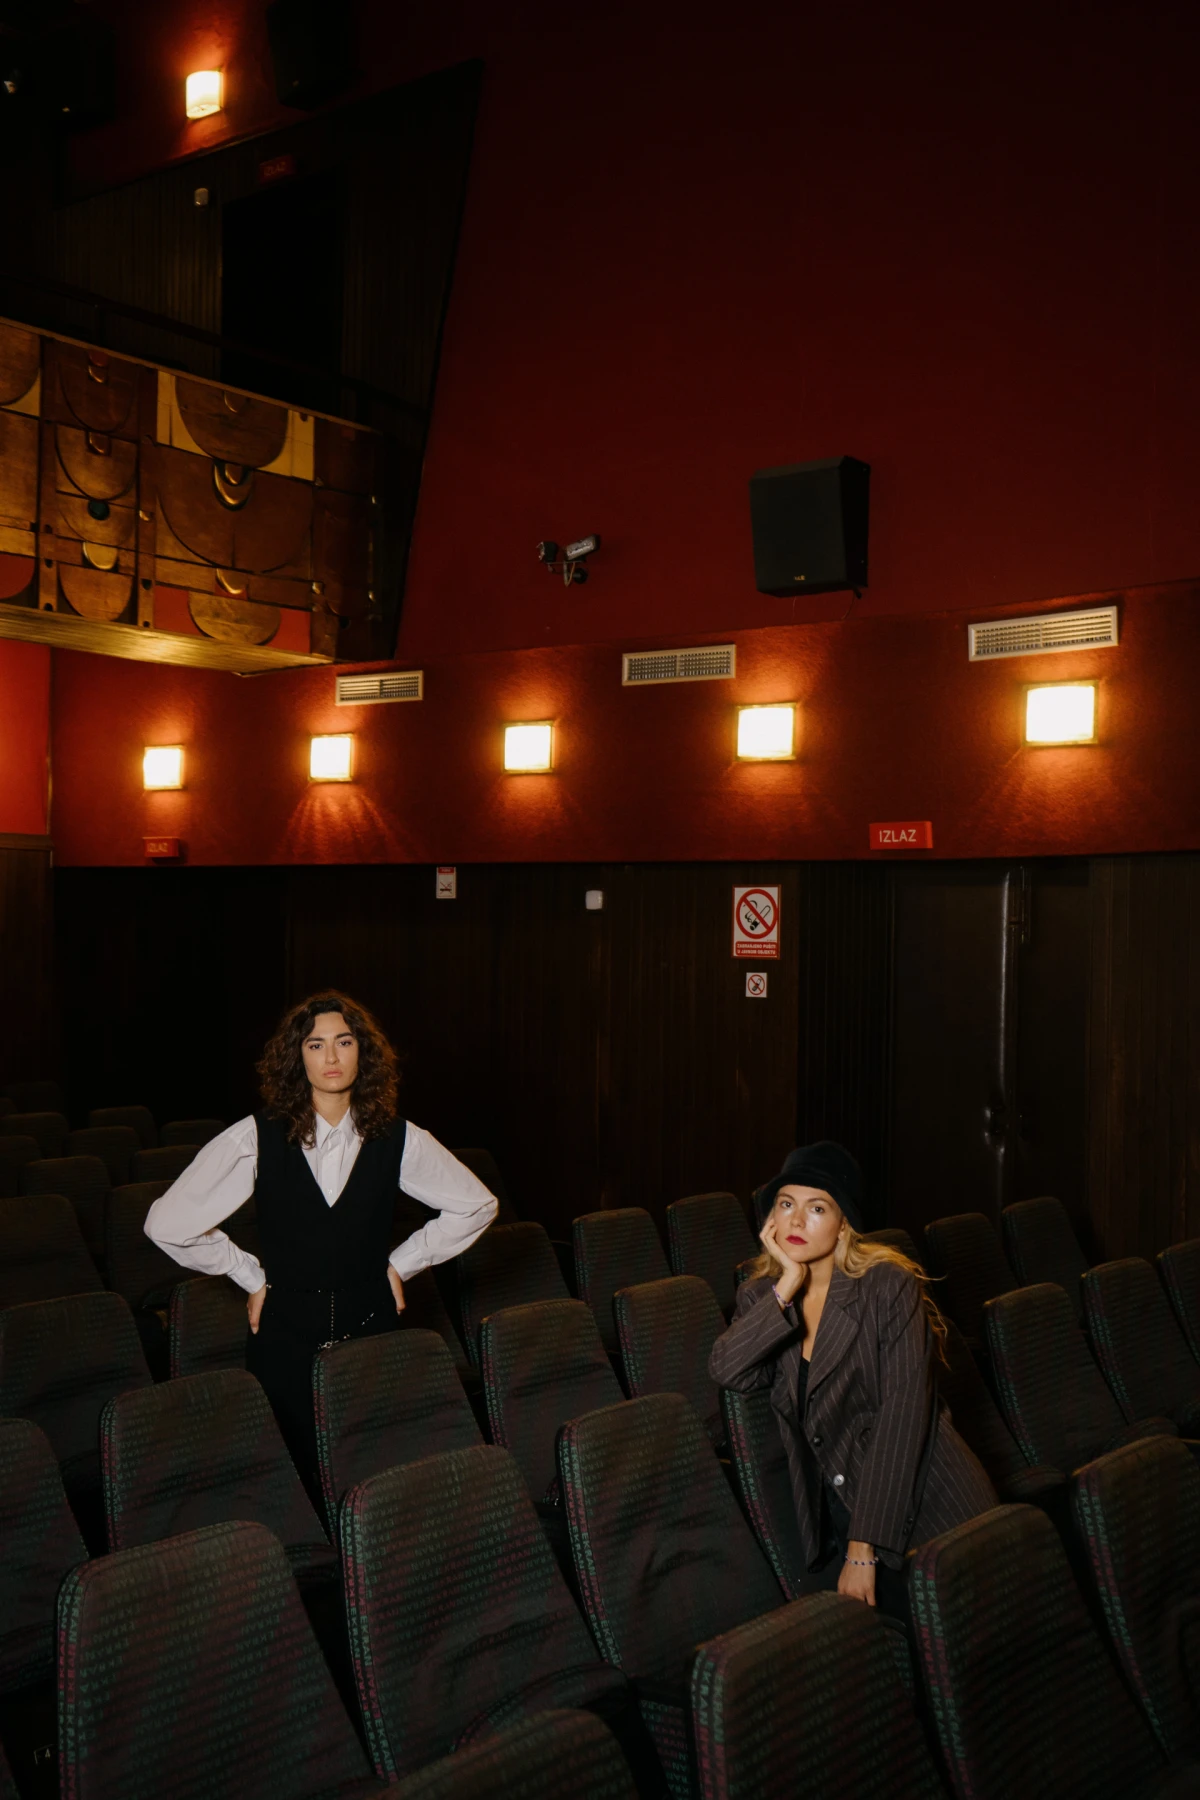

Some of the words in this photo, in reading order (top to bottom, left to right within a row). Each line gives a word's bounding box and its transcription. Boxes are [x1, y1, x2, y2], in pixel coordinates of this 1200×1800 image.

[879, 829, 917, 843] IZLAZ
[562, 1440, 572, 1482] EKRAN
[571, 1446, 582, 1488] EKRAN
[744, 1463, 758, 1501] EKRAN
[1079, 1489, 1095, 1536] EKRAN
[353, 1515, 364, 1563] EKRAN
[572, 1526, 585, 1570] EKRAN
[581, 1532, 596, 1576] EKRAN
[765, 1538, 783, 1577] EKRAN
[69, 1585, 83, 1642] EKRAN
[914, 1570, 928, 1624] EKRAN
[926, 1580, 943, 1636] EKRAN
[350, 1607, 361, 1657] EKRAN
[360, 1616, 372, 1666] EKRAN
[590, 1614, 607, 1658] EKRAN
[600, 1620, 620, 1665] EKRAN
[699, 1660, 715, 1726] EKRAN
[364, 1711, 380, 1762] EKRAN
[375, 1719, 395, 1771] EKRAN
